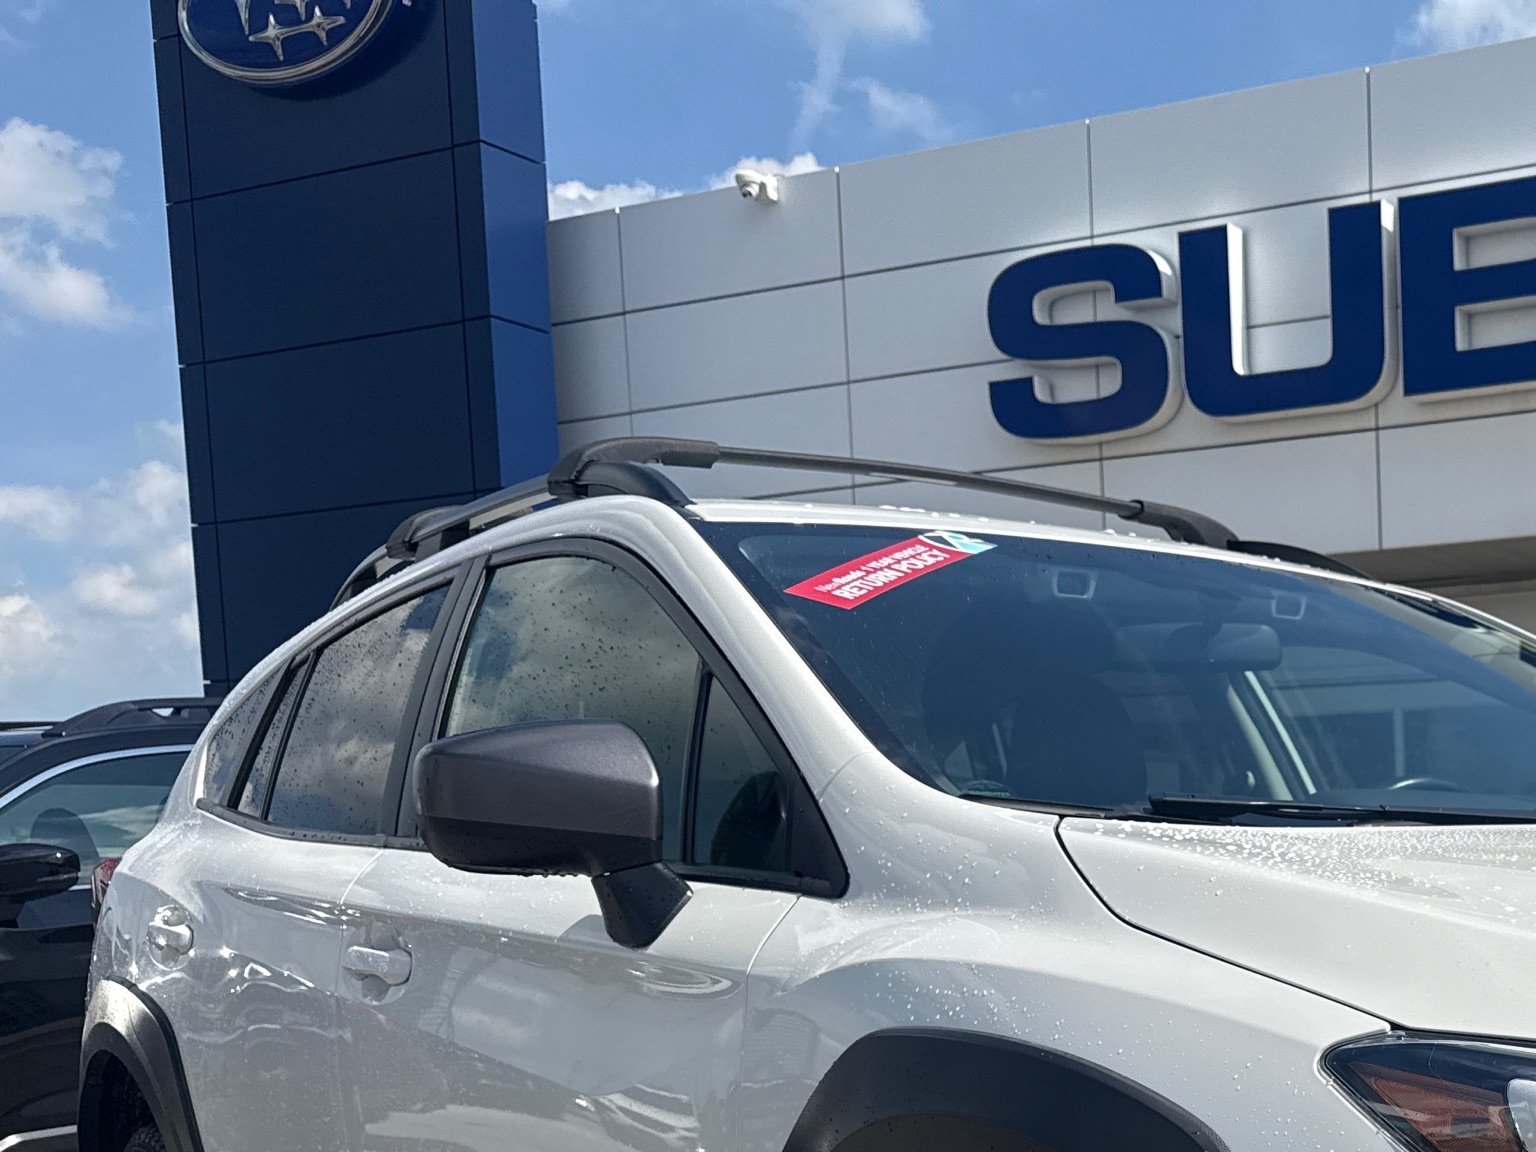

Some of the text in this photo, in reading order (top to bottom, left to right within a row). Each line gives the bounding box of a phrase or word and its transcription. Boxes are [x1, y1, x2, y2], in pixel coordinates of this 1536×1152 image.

[831, 548, 950, 600] RETURN POLICY
[866, 554, 896, 571] YEAR
[891, 544, 930, 561] VEHICLE
